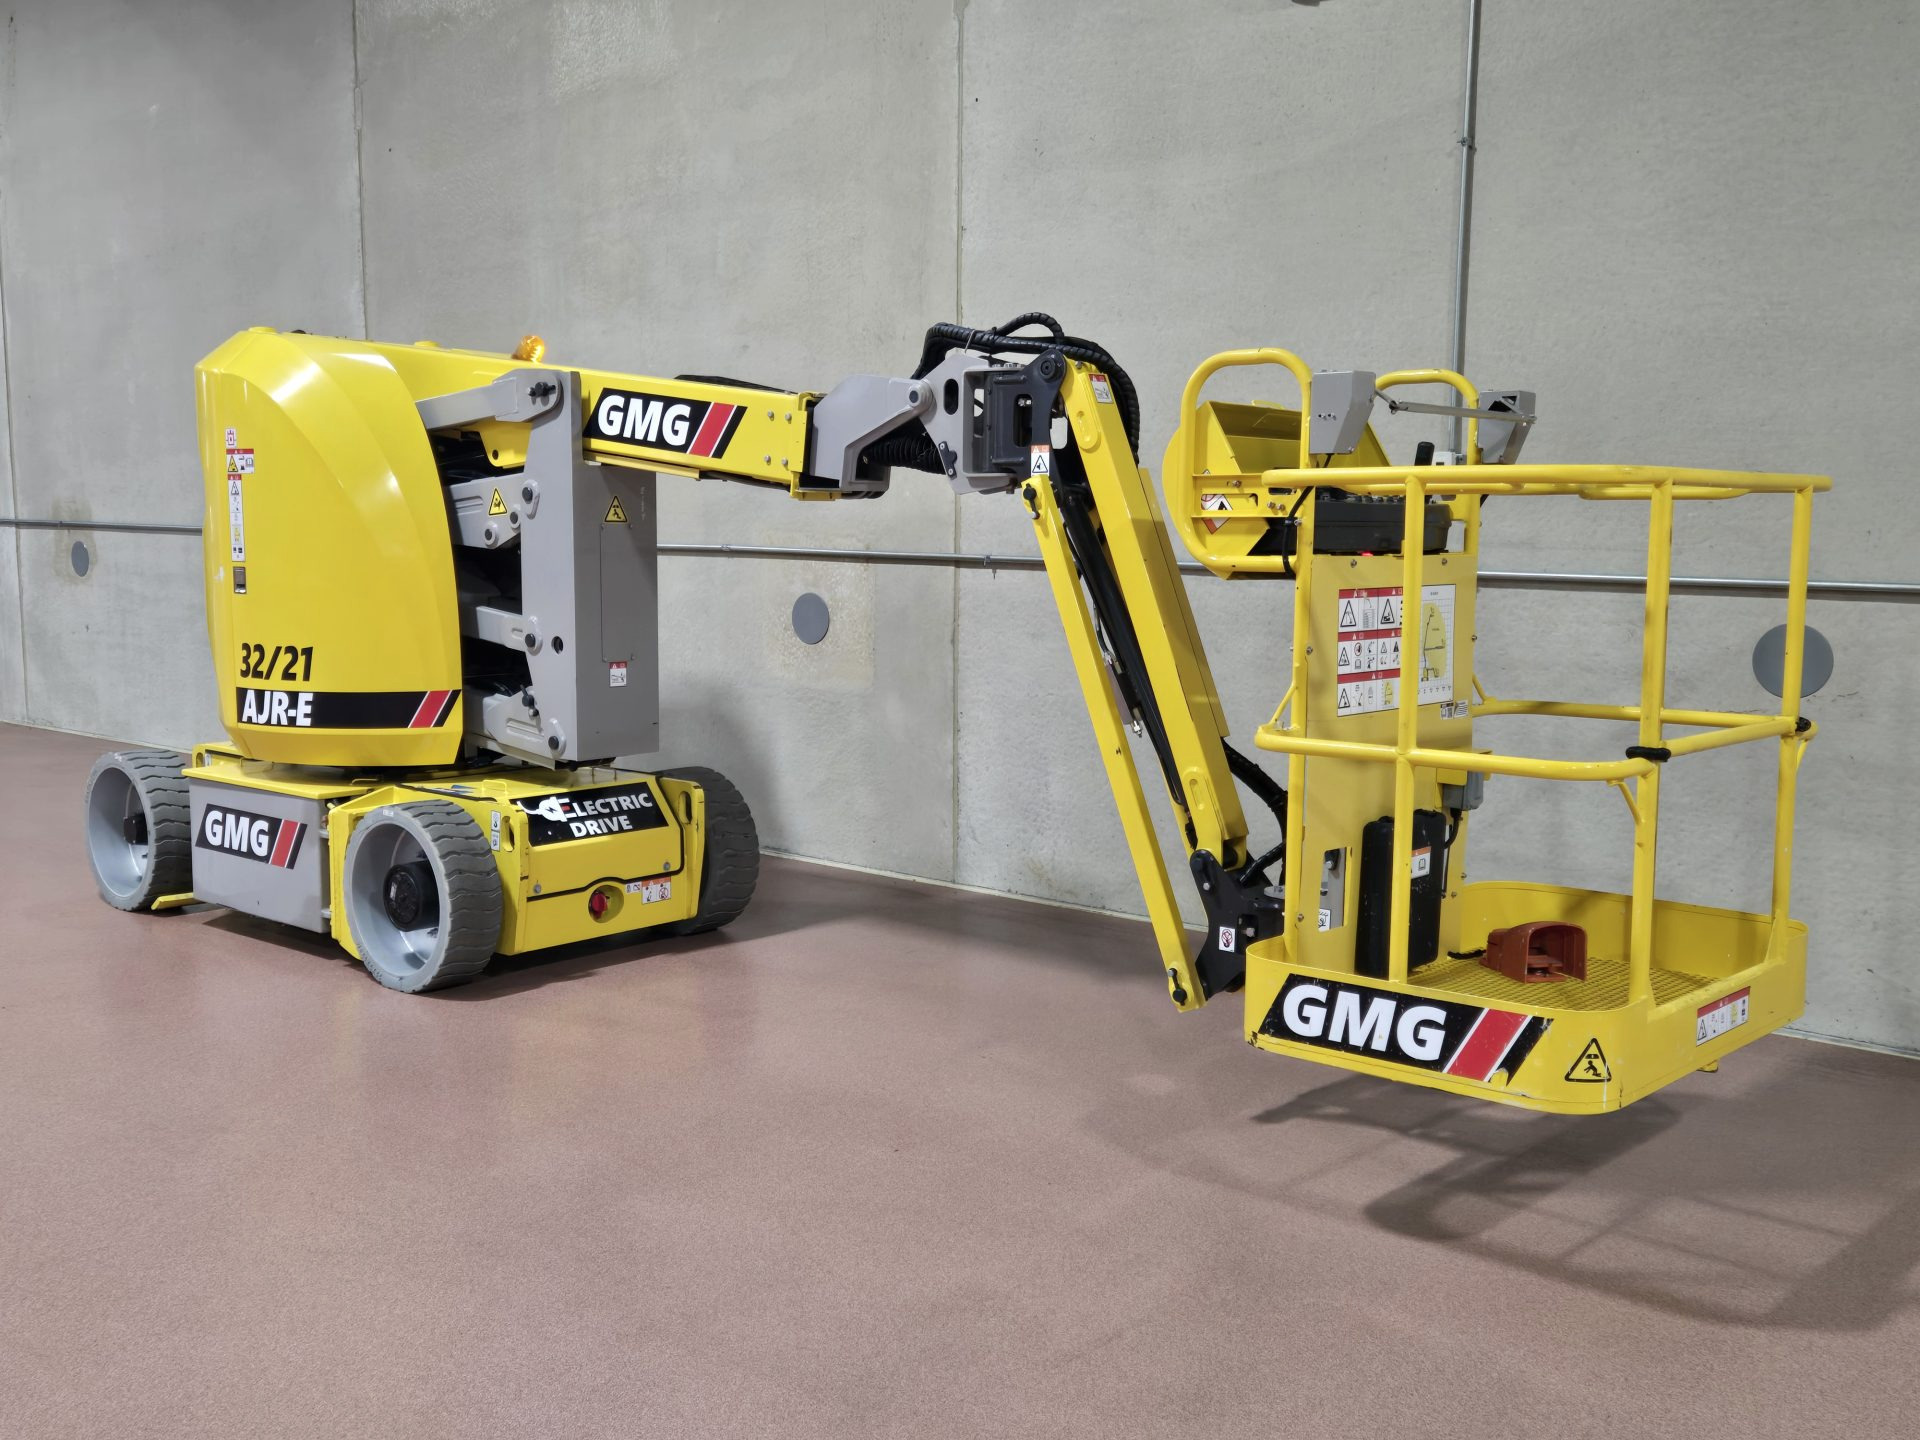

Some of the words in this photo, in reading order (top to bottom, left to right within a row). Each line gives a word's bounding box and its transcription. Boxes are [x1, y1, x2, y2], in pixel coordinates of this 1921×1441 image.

[598, 395, 691, 446] GMG
[240, 642, 313, 681] 32/21
[241, 689, 313, 726] AJR-E
[558, 793, 653, 819] ELECTRIC
[205, 810, 269, 857] GMG
[569, 815, 633, 838] DRIVE
[1283, 984, 1447, 1061] GMG
